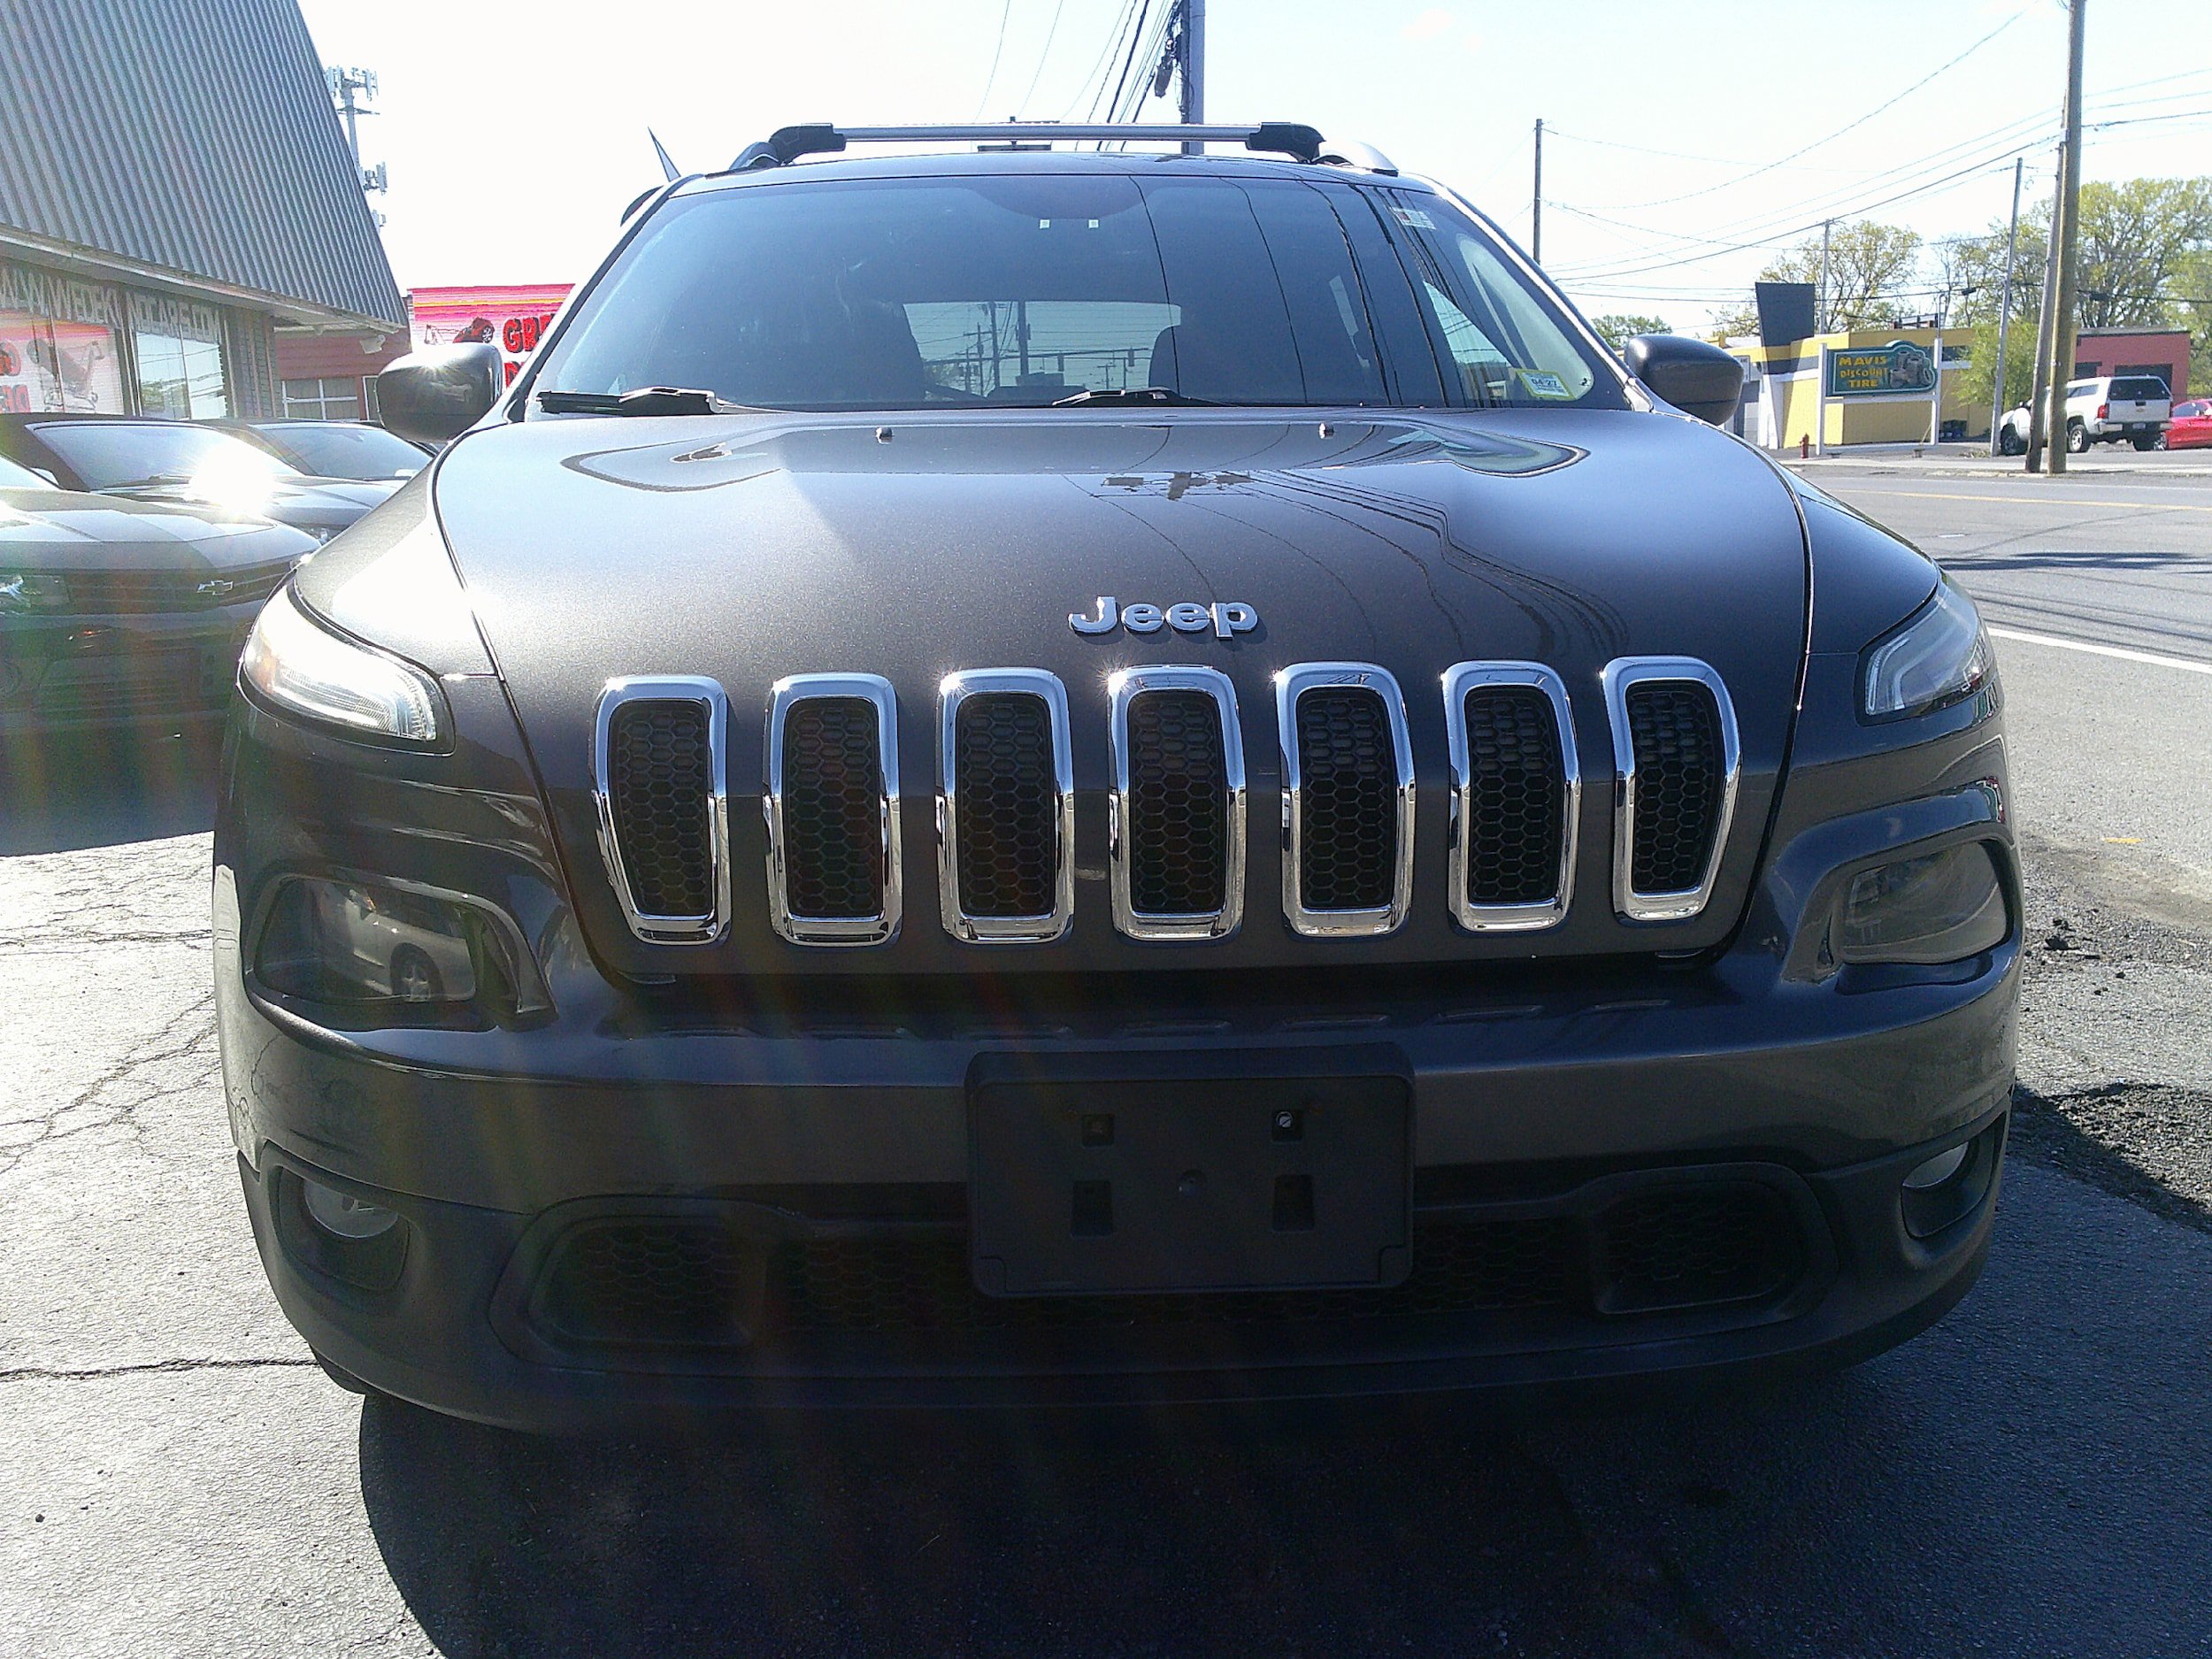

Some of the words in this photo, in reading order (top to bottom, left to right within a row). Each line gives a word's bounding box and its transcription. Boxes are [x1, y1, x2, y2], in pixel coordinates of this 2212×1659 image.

[1839, 356, 1888, 366] MAVIS
[1839, 366, 1888, 379] DISCOUNT
[1848, 379, 1878, 388] TIRE
[1068, 595, 1258, 641] Jeep
